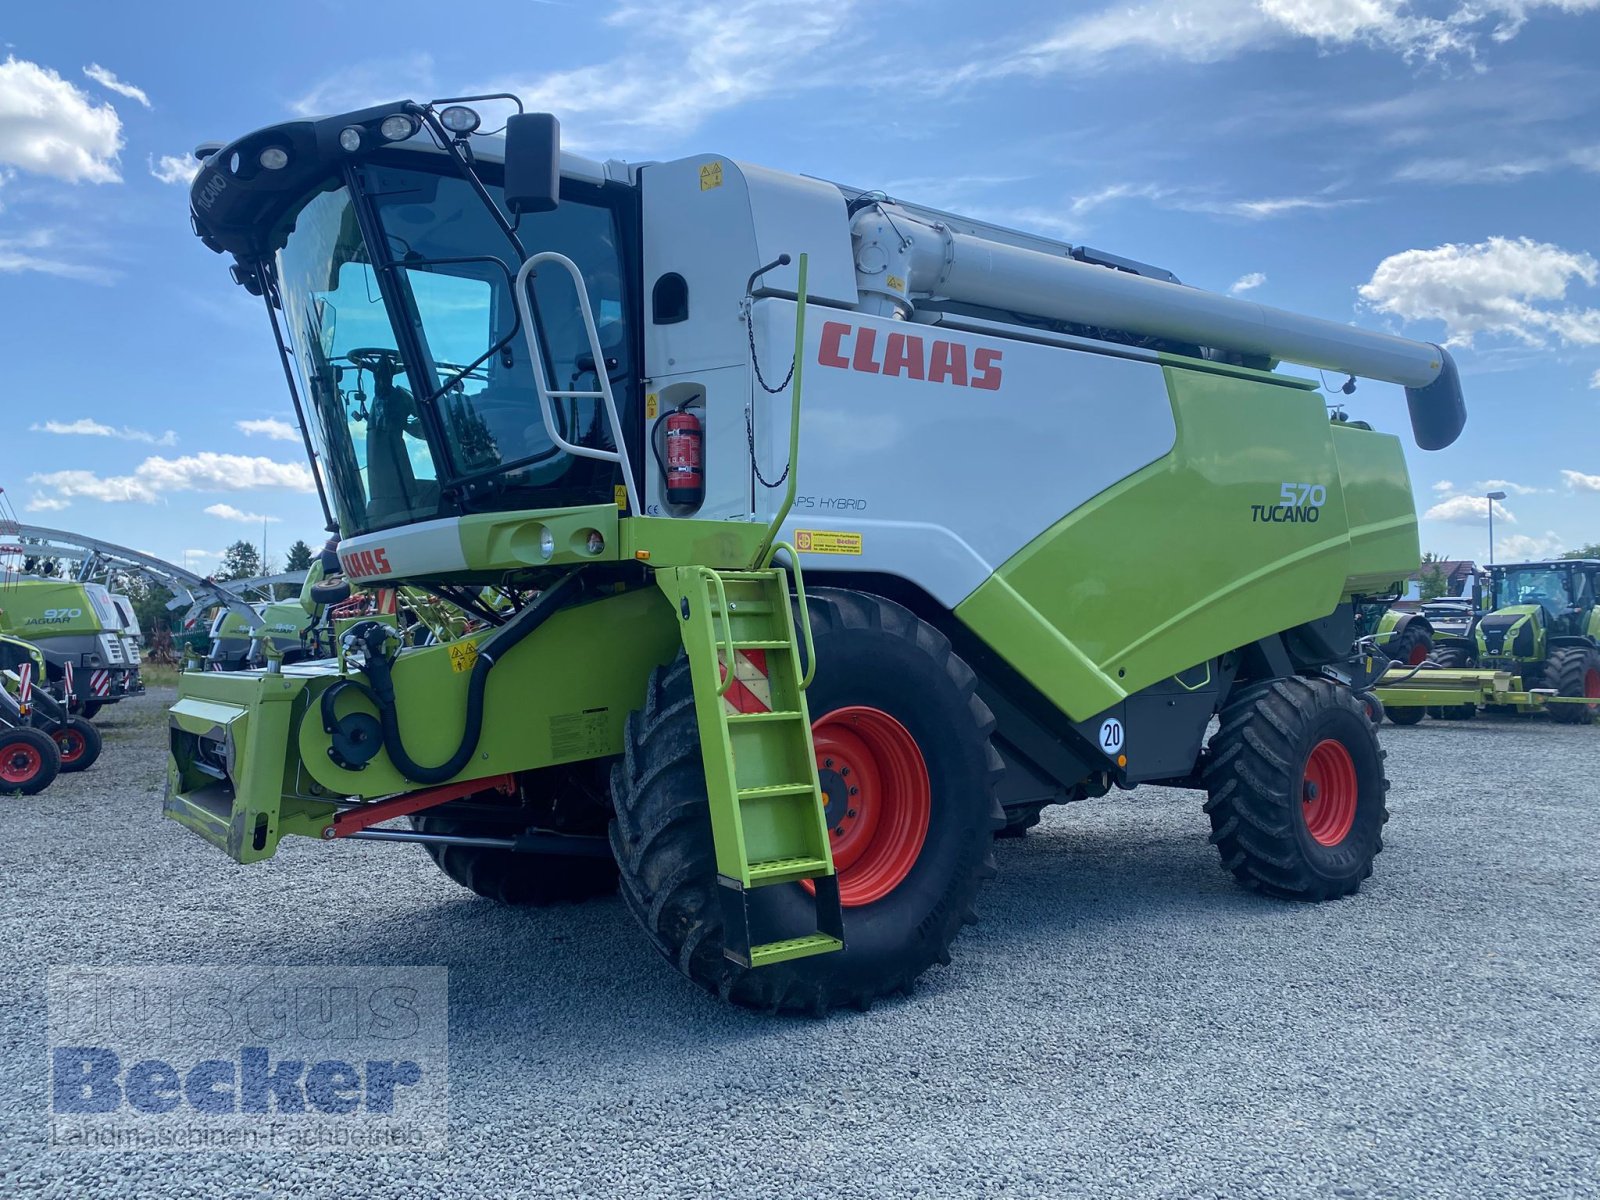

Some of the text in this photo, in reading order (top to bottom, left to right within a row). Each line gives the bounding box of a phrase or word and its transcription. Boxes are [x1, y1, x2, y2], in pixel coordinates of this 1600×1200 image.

[198, 174, 226, 212] TUCANO
[818, 321, 1003, 391] CLAAS
[820, 498, 867, 510] HYBRID
[1280, 482, 1327, 507] 570
[1251, 505, 1319, 523] TUCANO
[25, 617, 70, 626] JAGUAR
[44, 608, 82, 619] 970
[1104, 723, 1120, 747] 20
